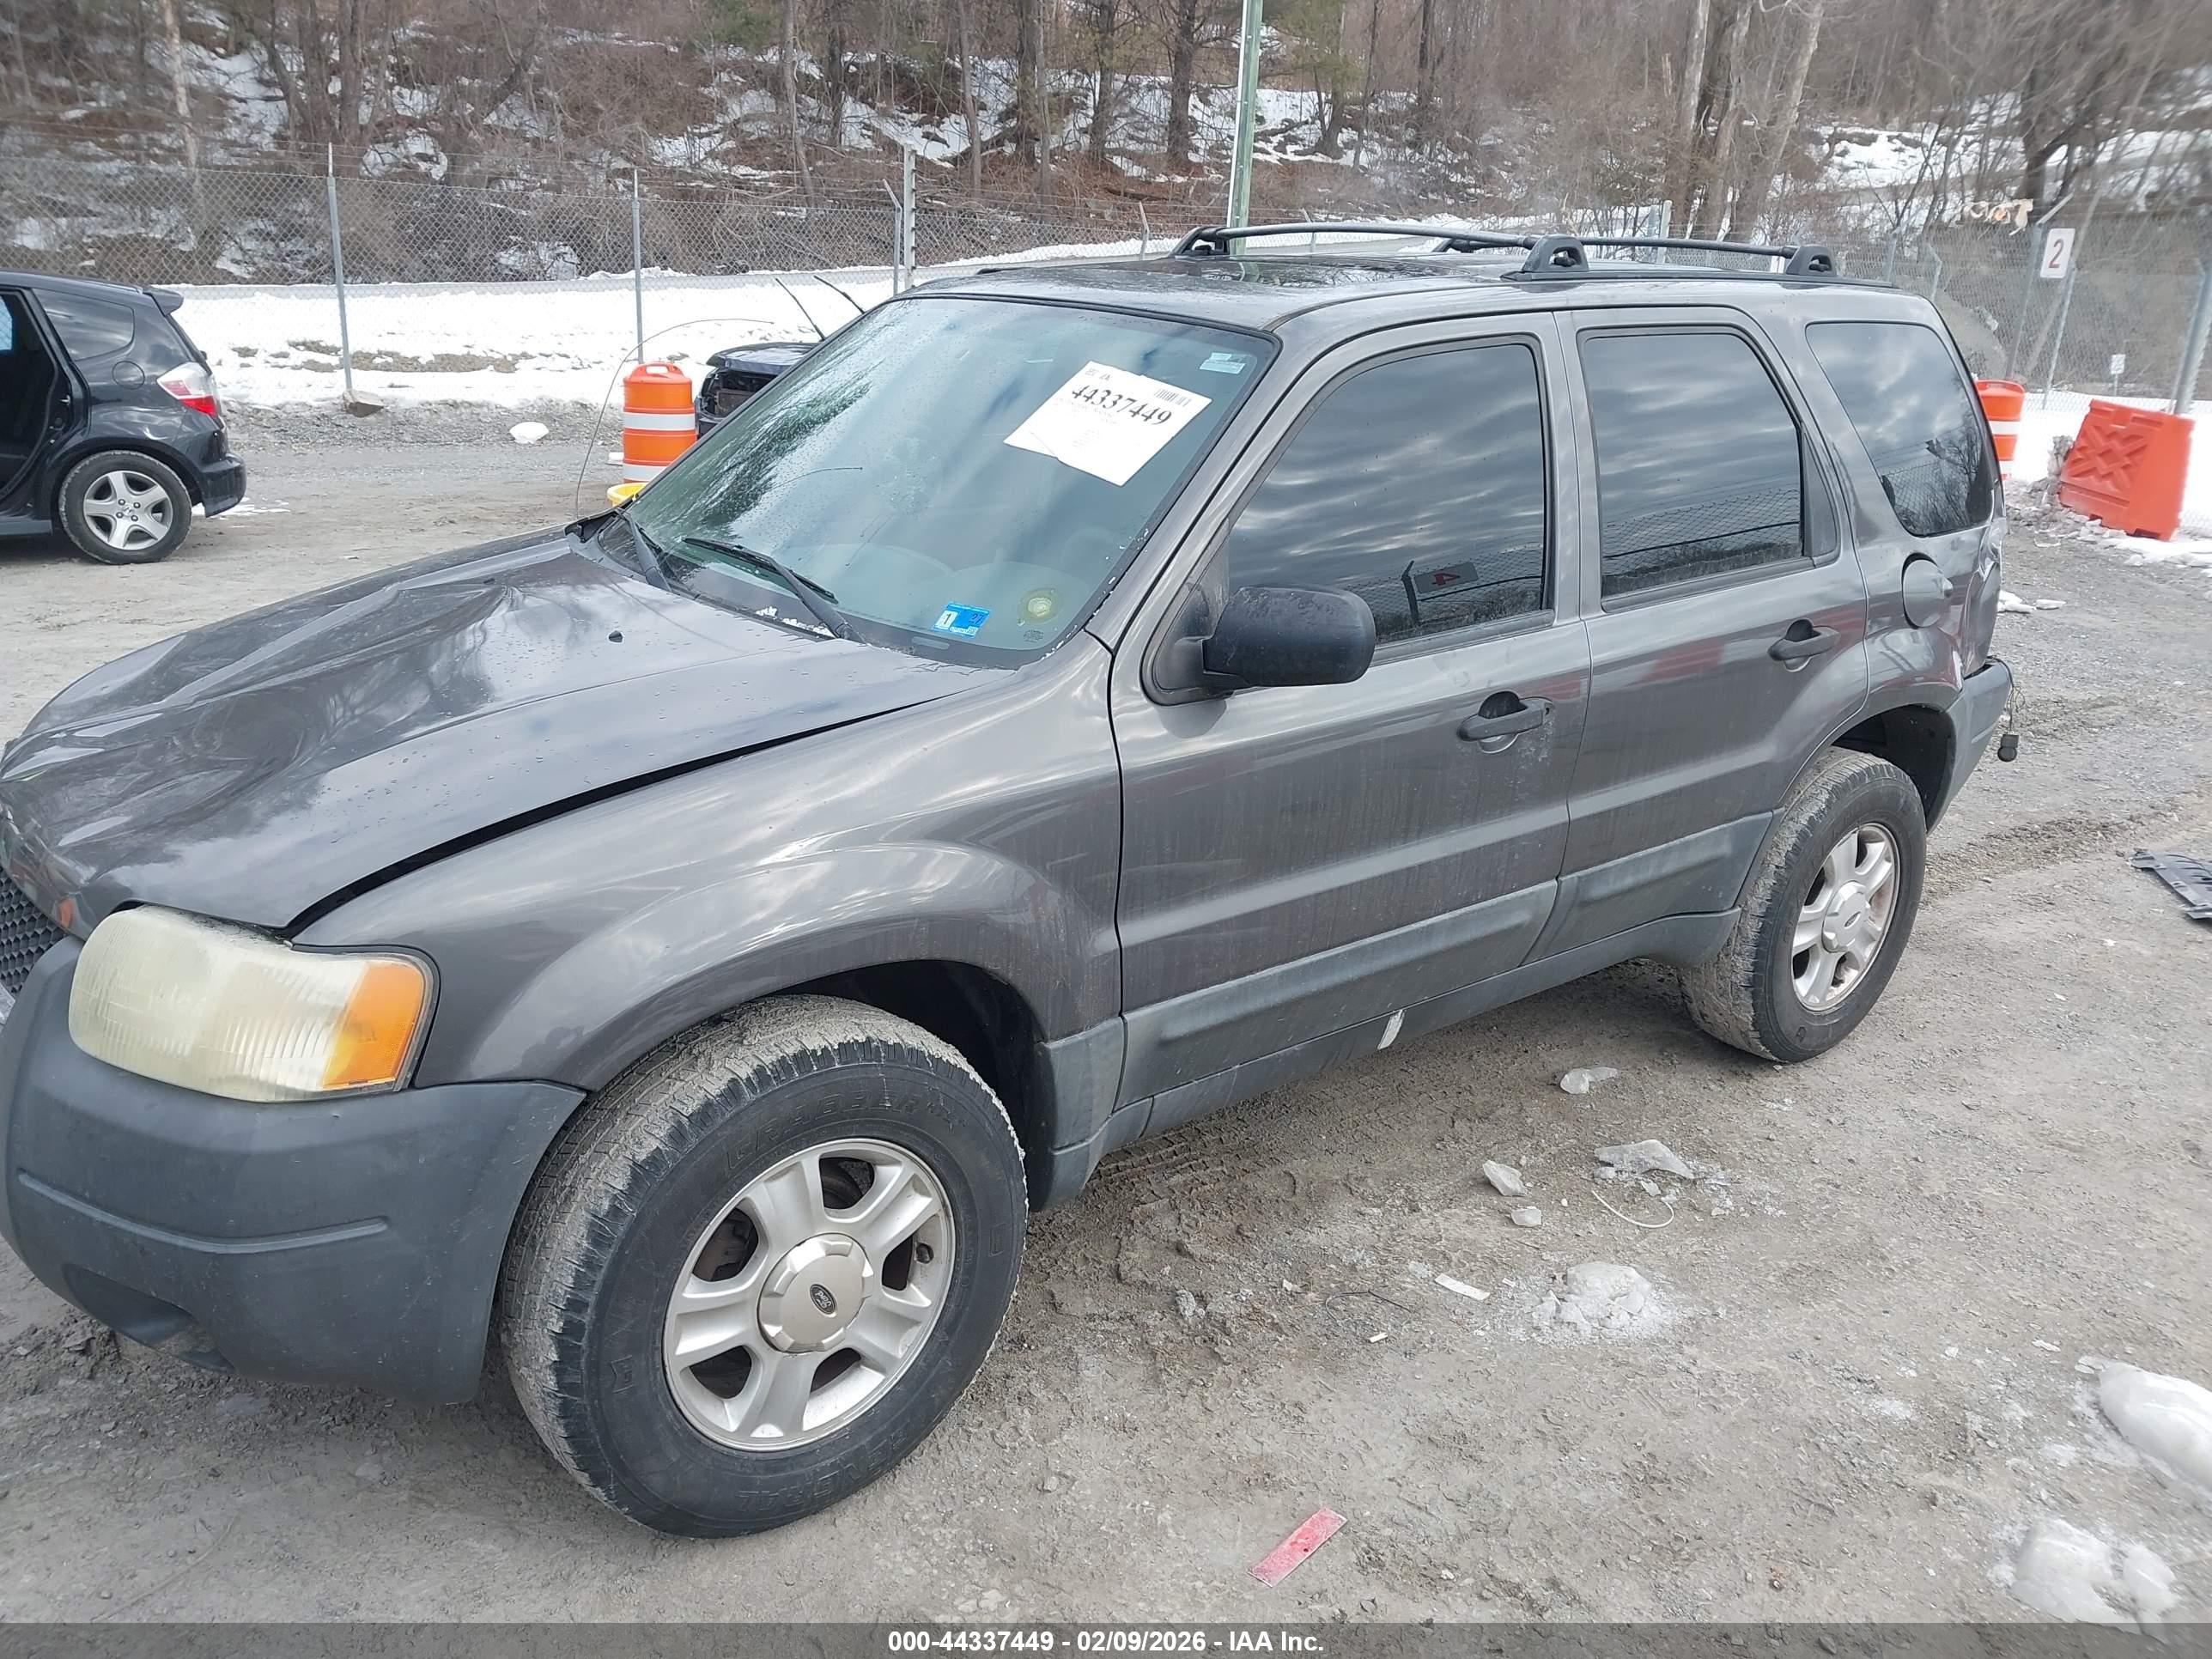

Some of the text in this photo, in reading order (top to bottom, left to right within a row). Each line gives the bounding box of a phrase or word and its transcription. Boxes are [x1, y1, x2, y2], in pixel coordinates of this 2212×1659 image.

[2049, 239, 2063, 268] 2
[1071, 384, 1173, 425] 44337449
[944, 612, 951, 625] 1
[812, 1287, 834, 1311] Ford
